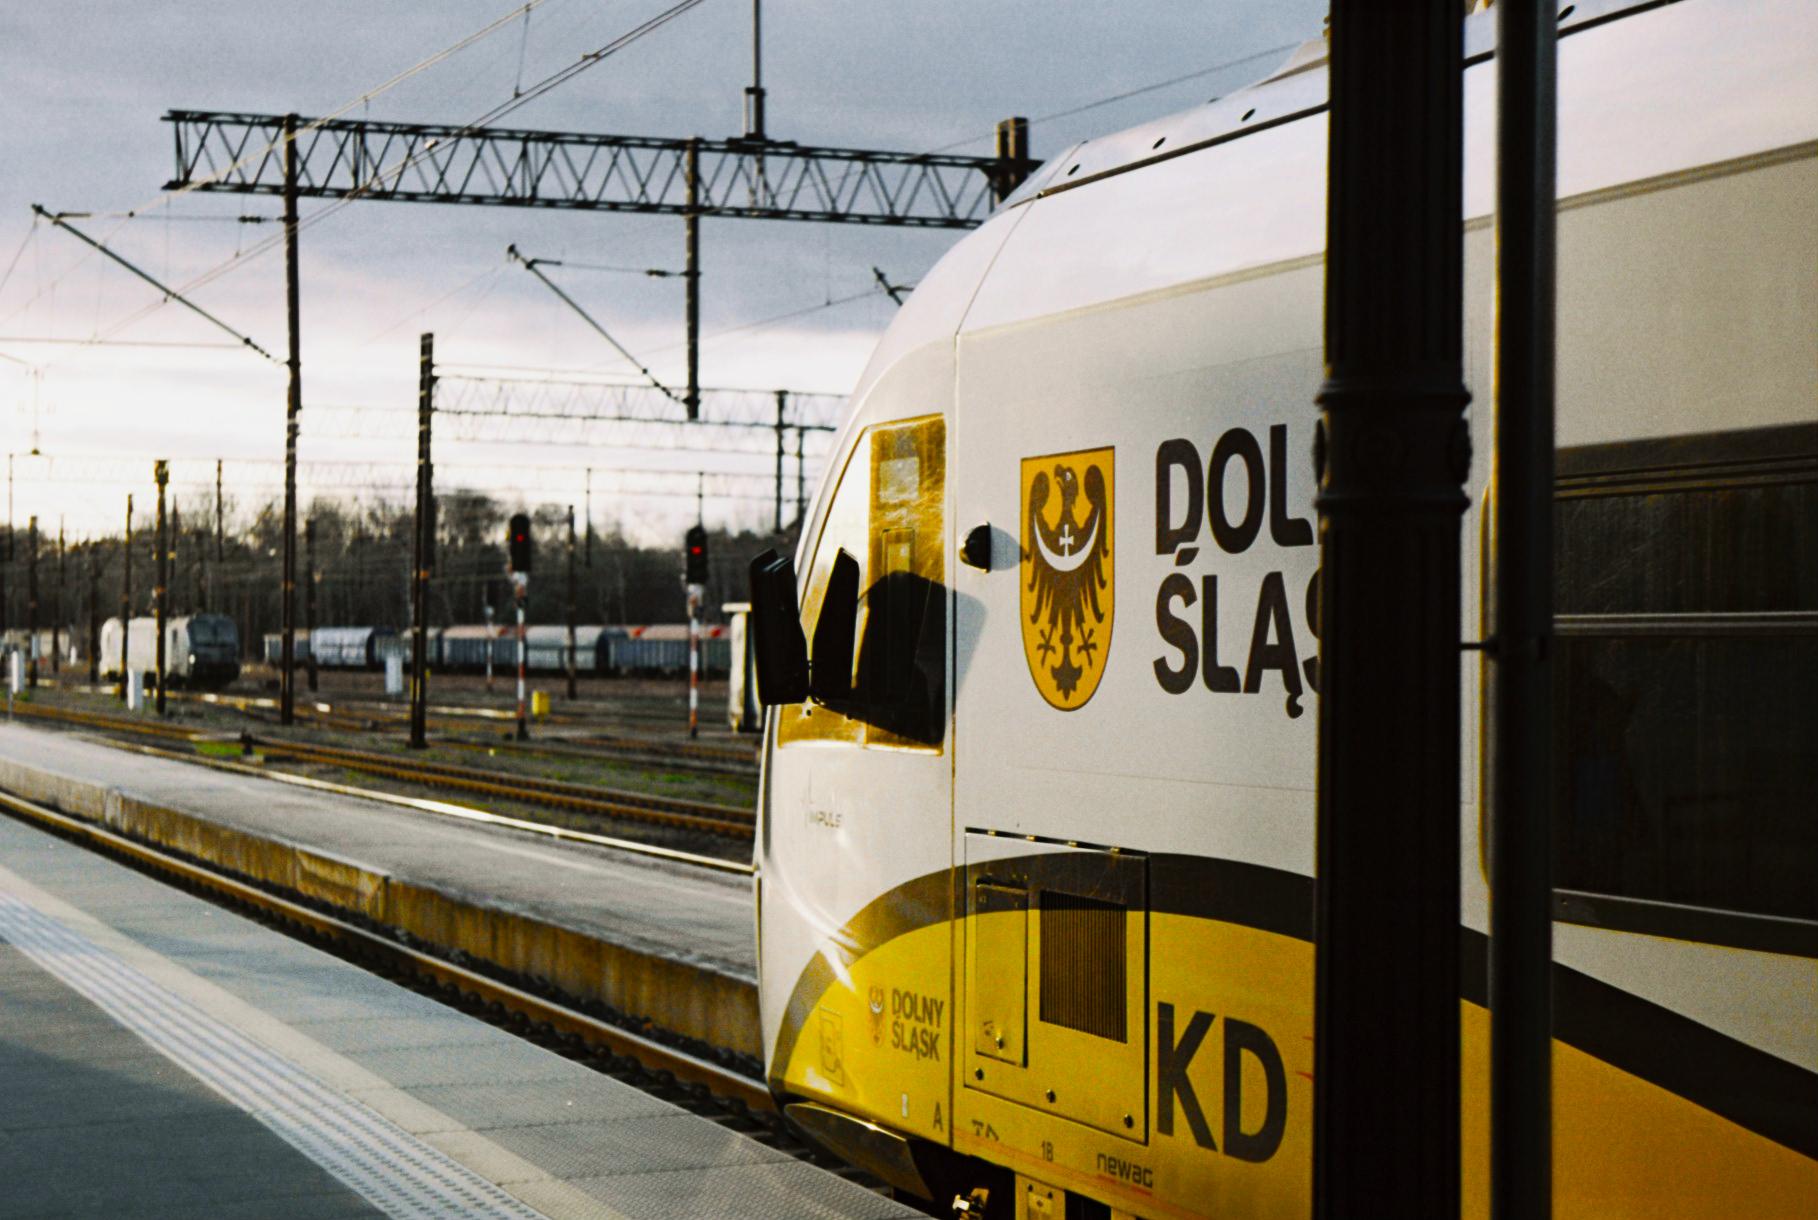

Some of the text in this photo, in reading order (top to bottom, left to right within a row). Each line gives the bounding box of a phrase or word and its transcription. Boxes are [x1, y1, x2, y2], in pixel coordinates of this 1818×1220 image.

[1156, 423, 1314, 555] DOL
[1153, 547, 1320, 719] ŚLĄ
[892, 987, 944, 1028] DOLNY
[892, 1014, 940, 1062] ŚLĄSK
[933, 1101, 944, 1132] A
[1157, 1001, 1288, 1163] KD
